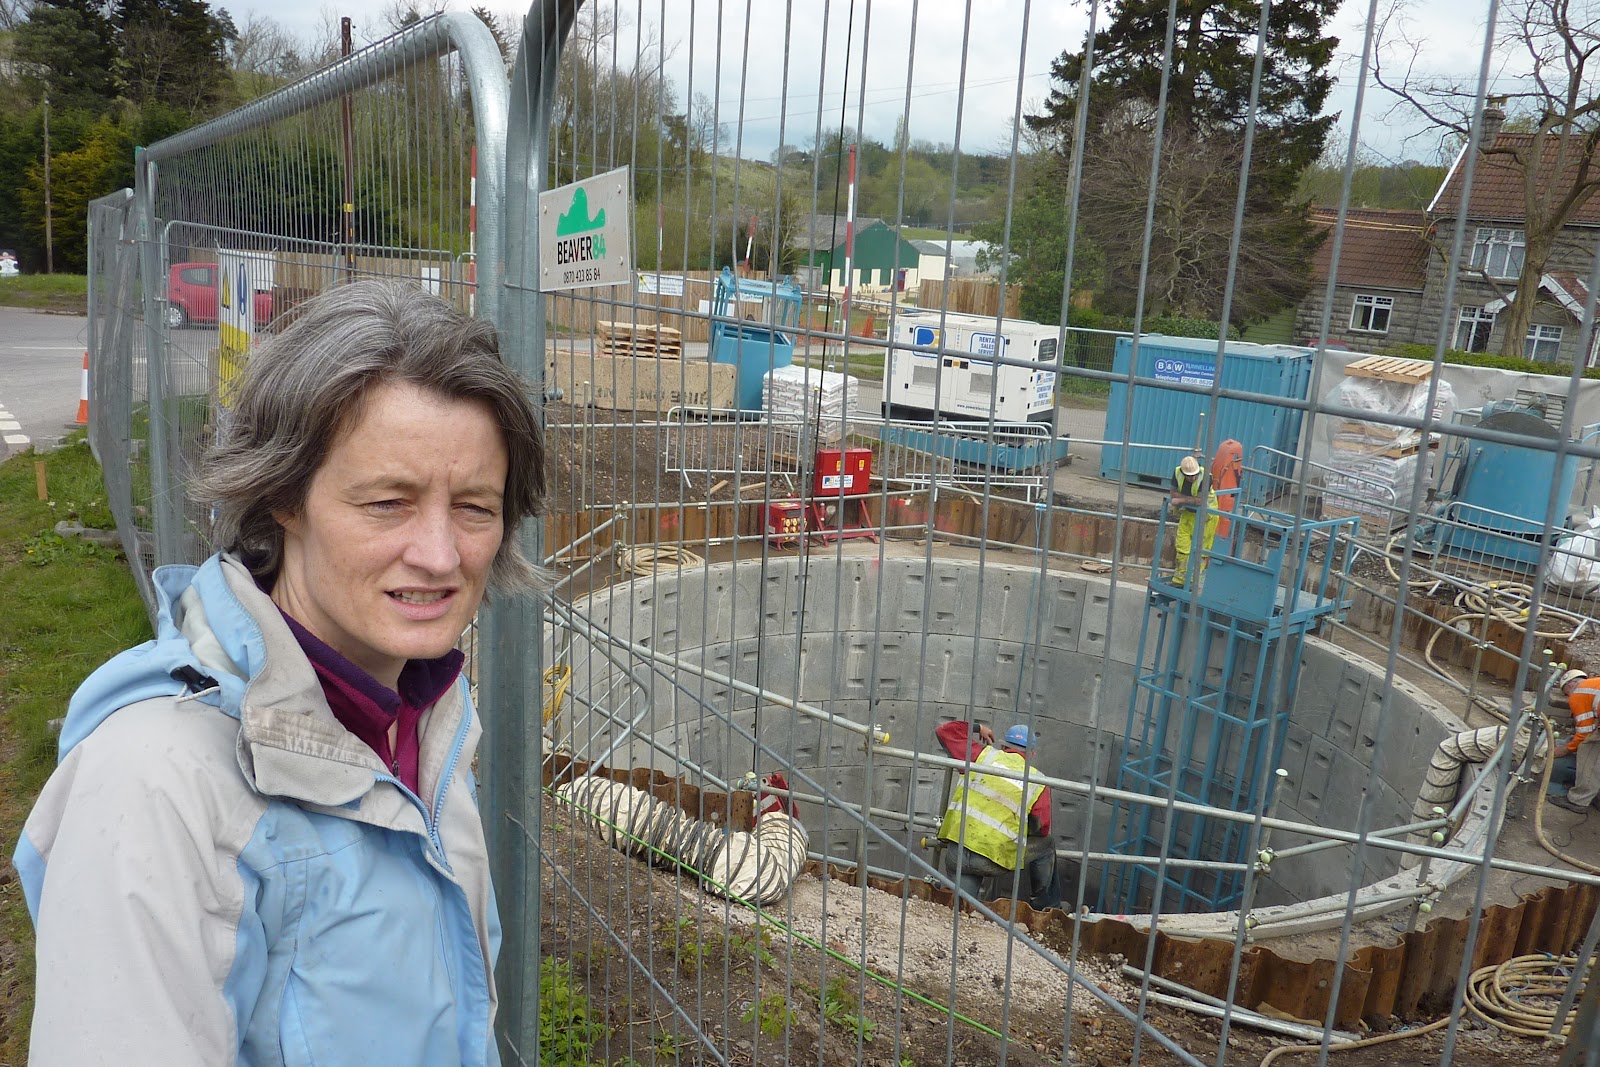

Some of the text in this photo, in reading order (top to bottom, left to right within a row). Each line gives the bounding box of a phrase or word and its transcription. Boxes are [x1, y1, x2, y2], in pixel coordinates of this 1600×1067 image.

[557, 233, 606, 264] BEAVER84
[563, 271, 575, 284] 0870
[586, 268, 592, 281] 85
[594, 267, 600, 280] 84
[1185, 363, 1217, 371] TUNNELLIN
